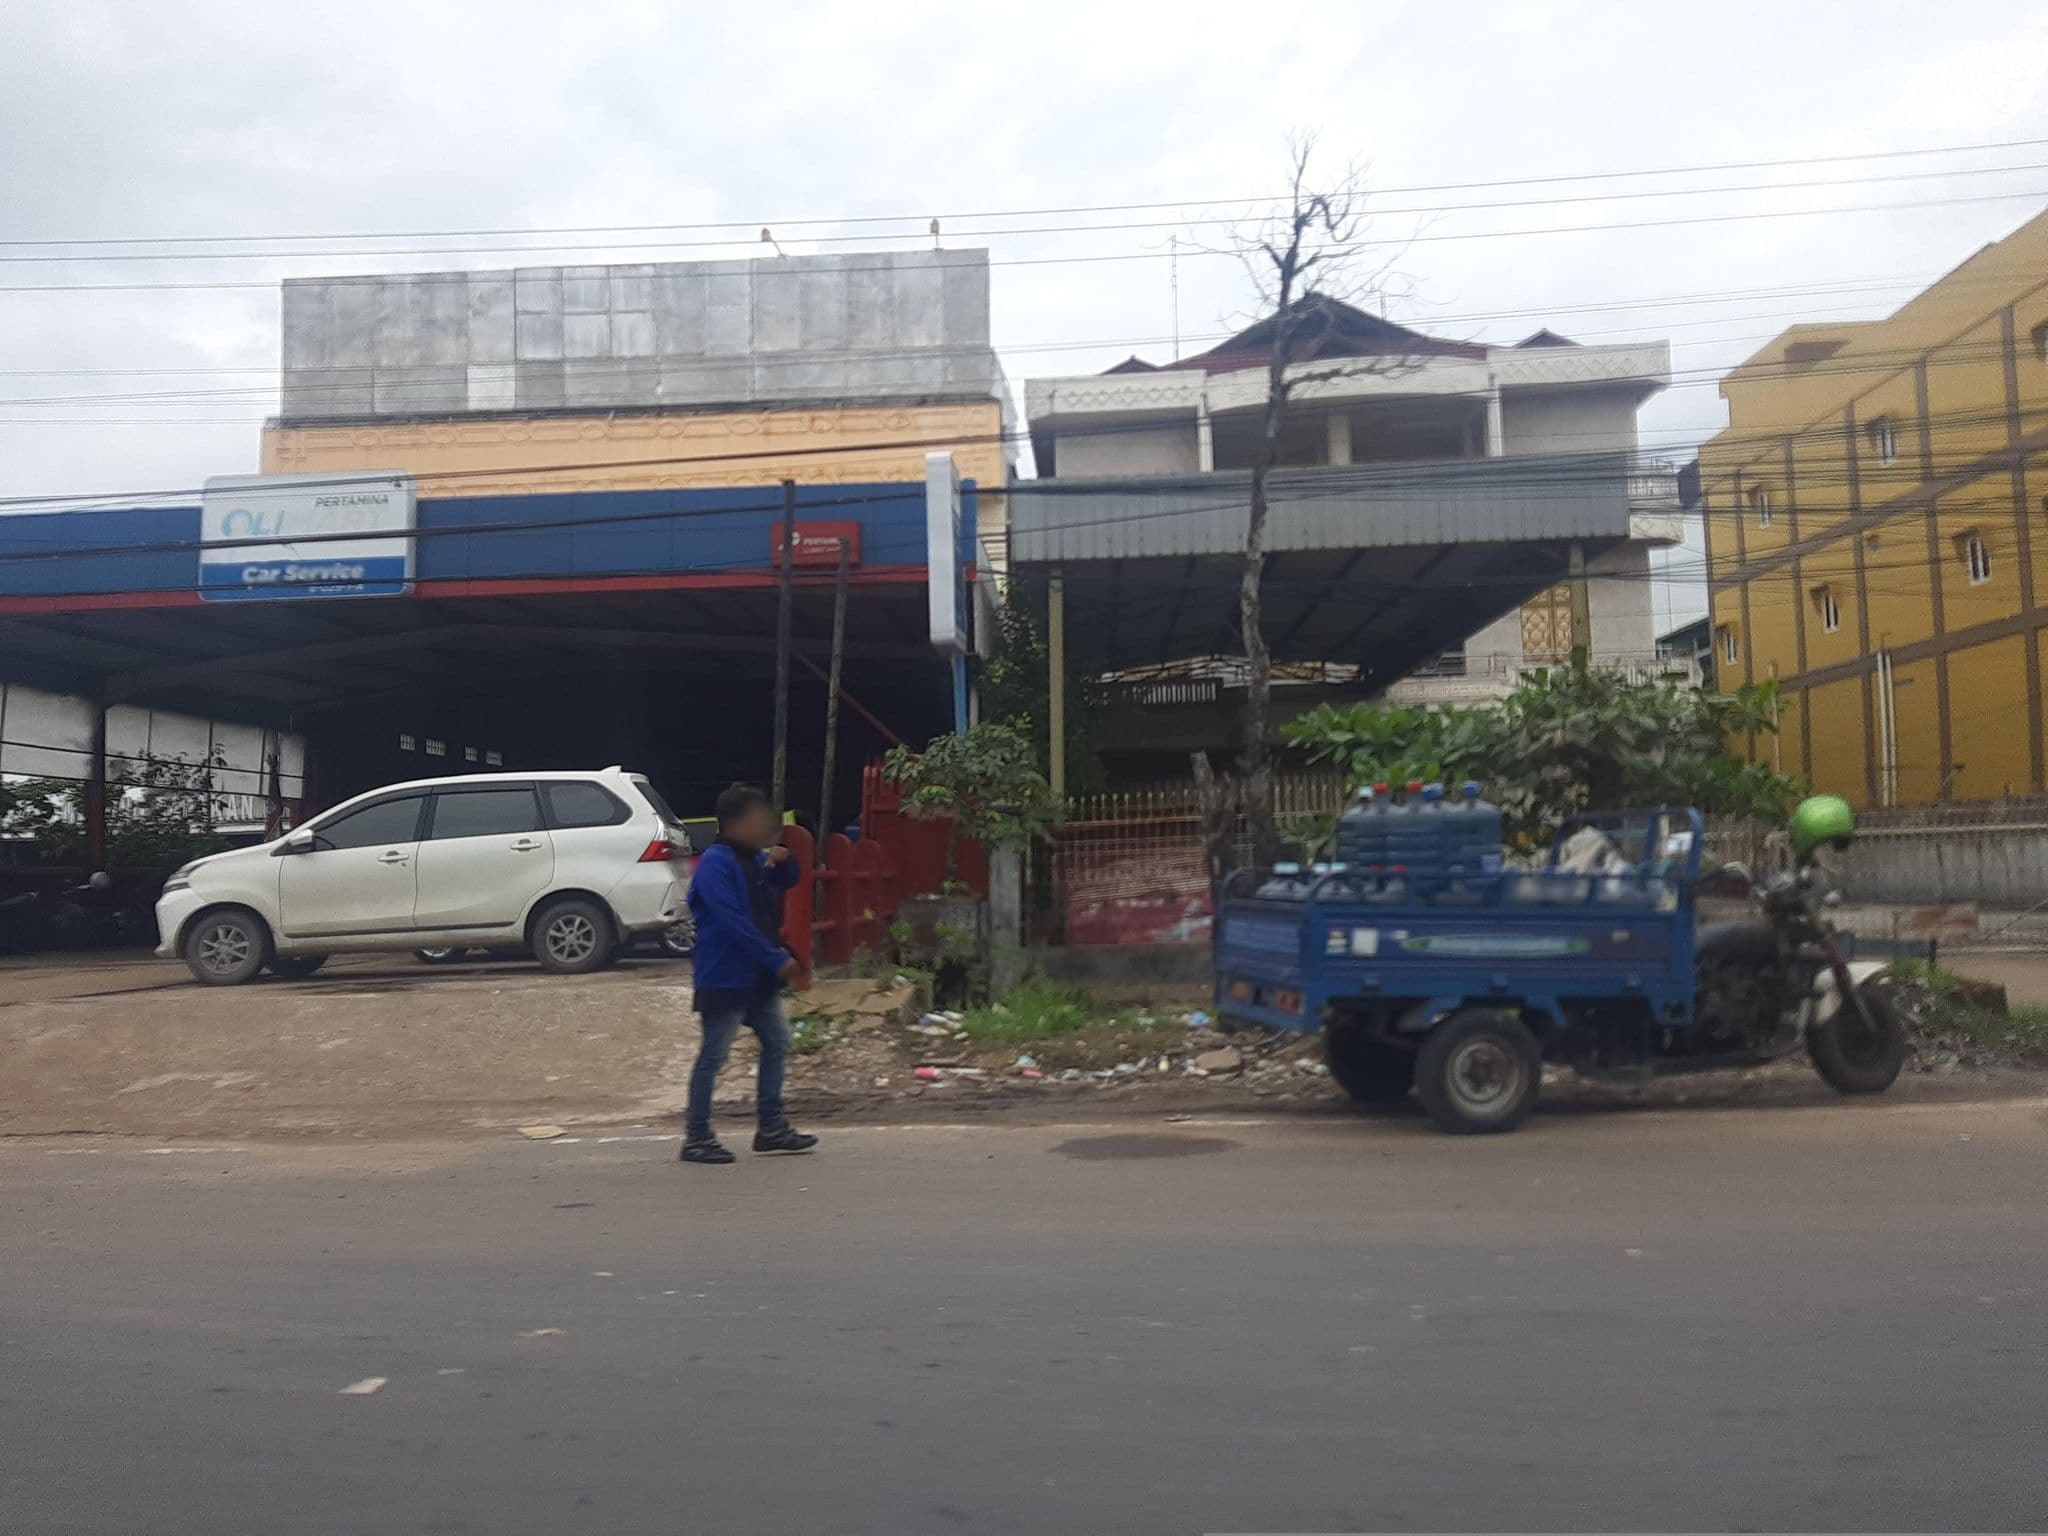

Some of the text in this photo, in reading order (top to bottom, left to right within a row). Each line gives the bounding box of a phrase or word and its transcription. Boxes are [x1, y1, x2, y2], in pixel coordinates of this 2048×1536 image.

[315, 494, 389, 508] PERTAMINA
[242, 562, 365, 583] Car Service
